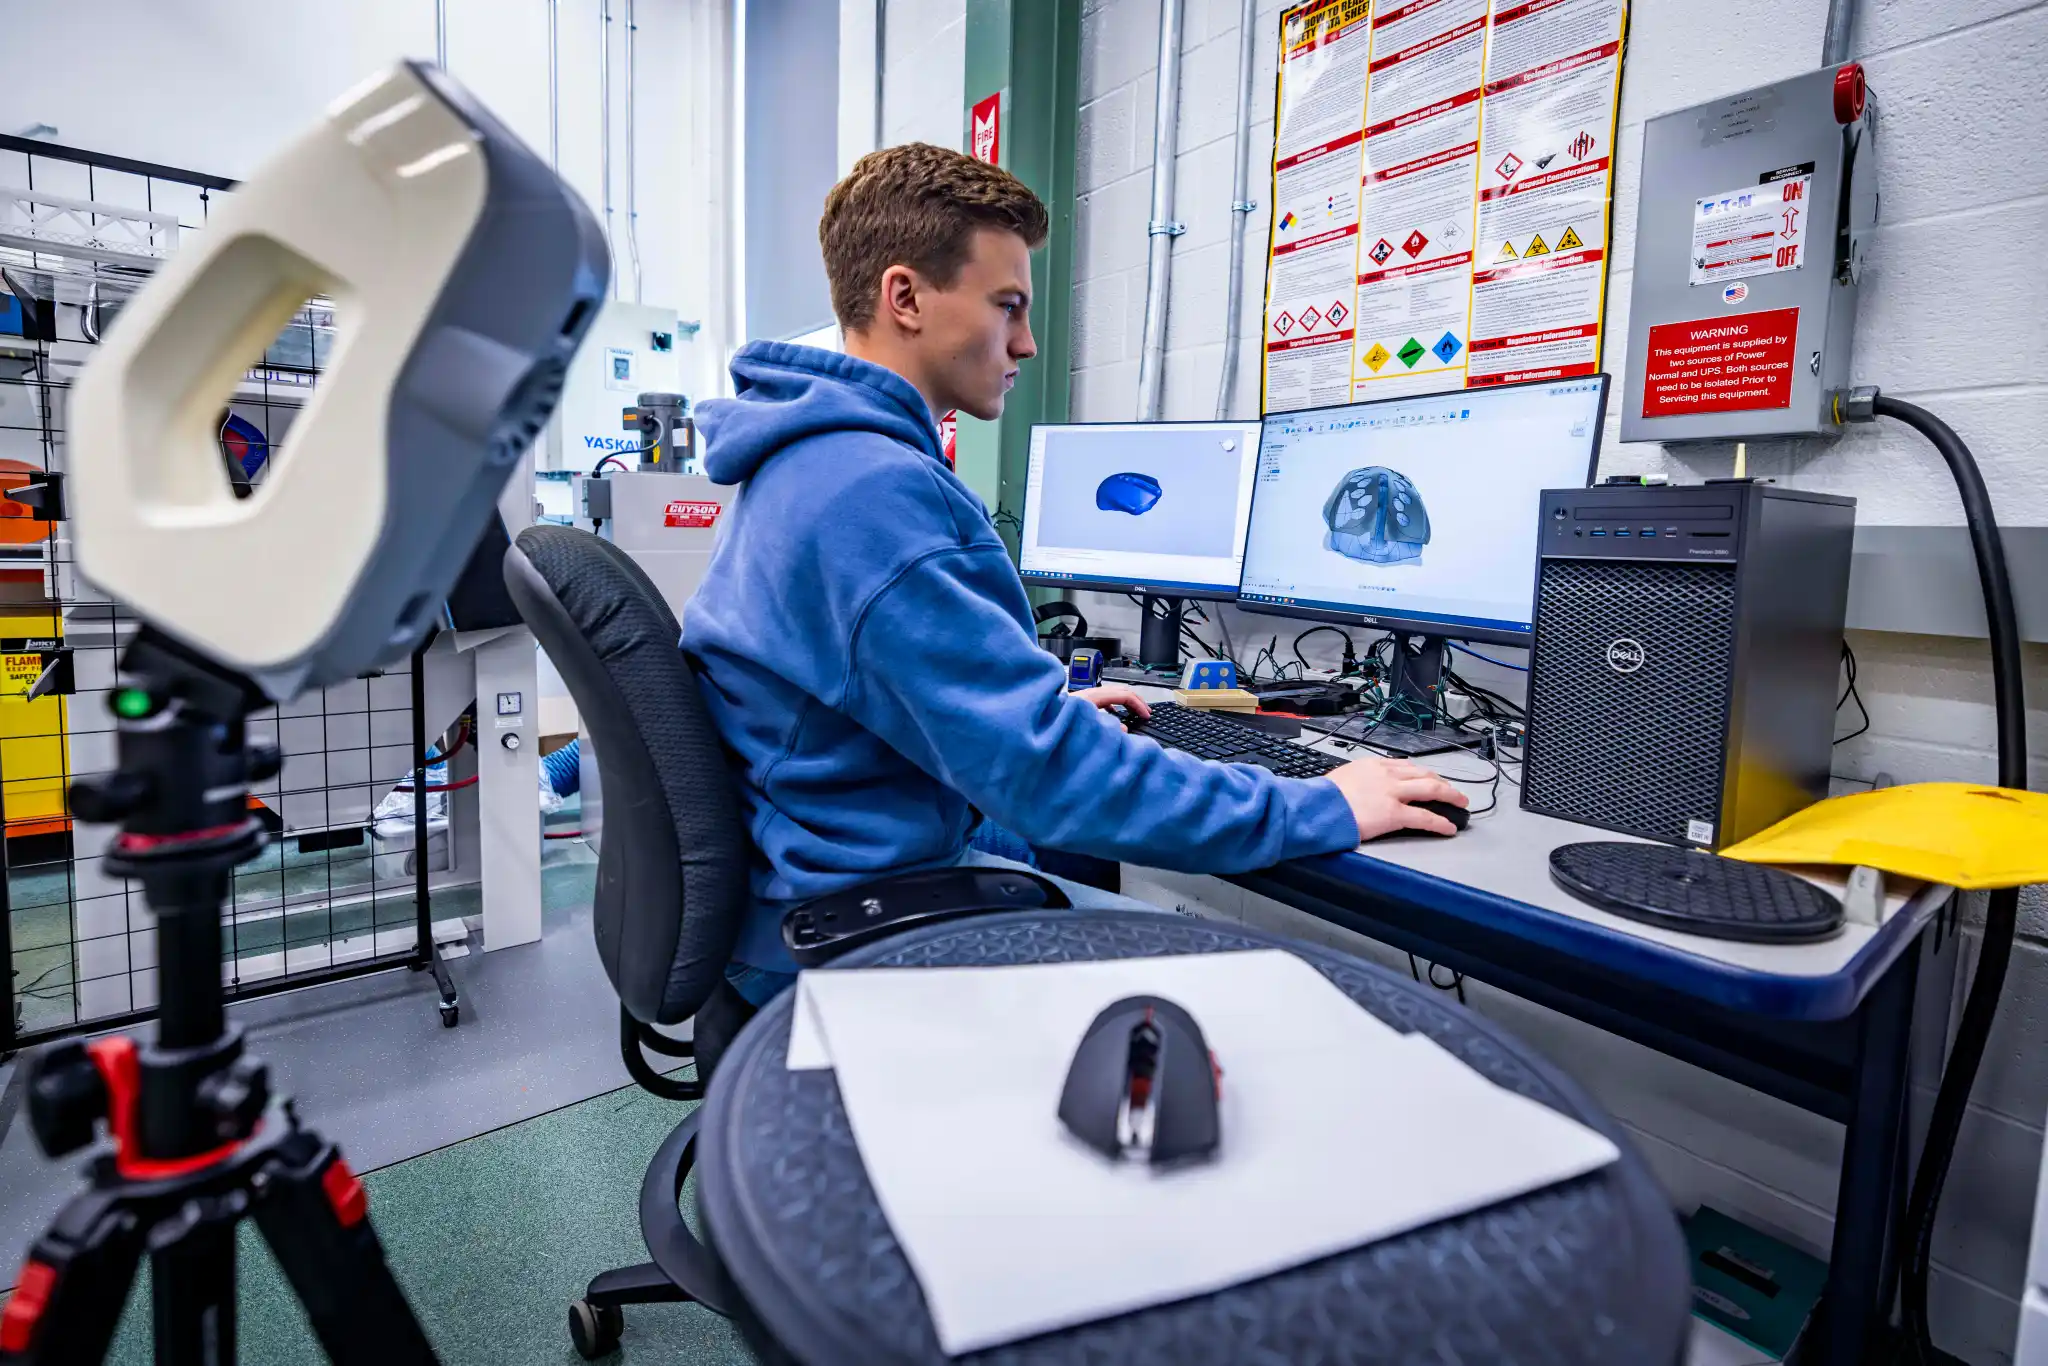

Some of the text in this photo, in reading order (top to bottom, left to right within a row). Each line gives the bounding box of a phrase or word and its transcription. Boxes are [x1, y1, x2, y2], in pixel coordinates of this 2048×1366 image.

[1304, 11, 1326, 30] HOW
[1328, 4, 1340, 18] TO
[1399, 42, 1429, 60] Accidental
[1452, 20, 1482, 38] Measures
[1524, 62, 1559, 82] Ecological
[1560, 50, 1602, 71] Information
[1430, 101, 1454, 115] Storage
[977, 125, 993, 146] FIRE
[1518, 162, 1600, 191] Disposal Considerations
[1770, 169, 1803, 181] DISCONNECT
[1775, 166, 1798, 176] SERVICE
[1782, 181, 1804, 202] ON
[1776, 244, 1798, 268] OFF
[1507, 334, 1543, 345] Regulatory
[1543, 328, 1583, 341] Information
[1690, 324, 1749, 341] WARNING
[1654, 335, 1788, 357] This equipment is supplied by
[1669, 350, 1767, 368] two sources of Power
[1504, 374, 1522, 382] Other
[1522, 369, 1562, 381] Information
[1649, 361, 1789, 381] Normal and UPS. Both sources
[1656, 374, 1777, 392] need to be isolated Prior to
[1659, 387, 1771, 404] Servicing this equipment.
[670, 504, 718, 515] GUYSON
[1363, 616, 1379, 624] DELL
[30, 640, 56, 648] amco
[1611, 650, 1641, 661] DELL
